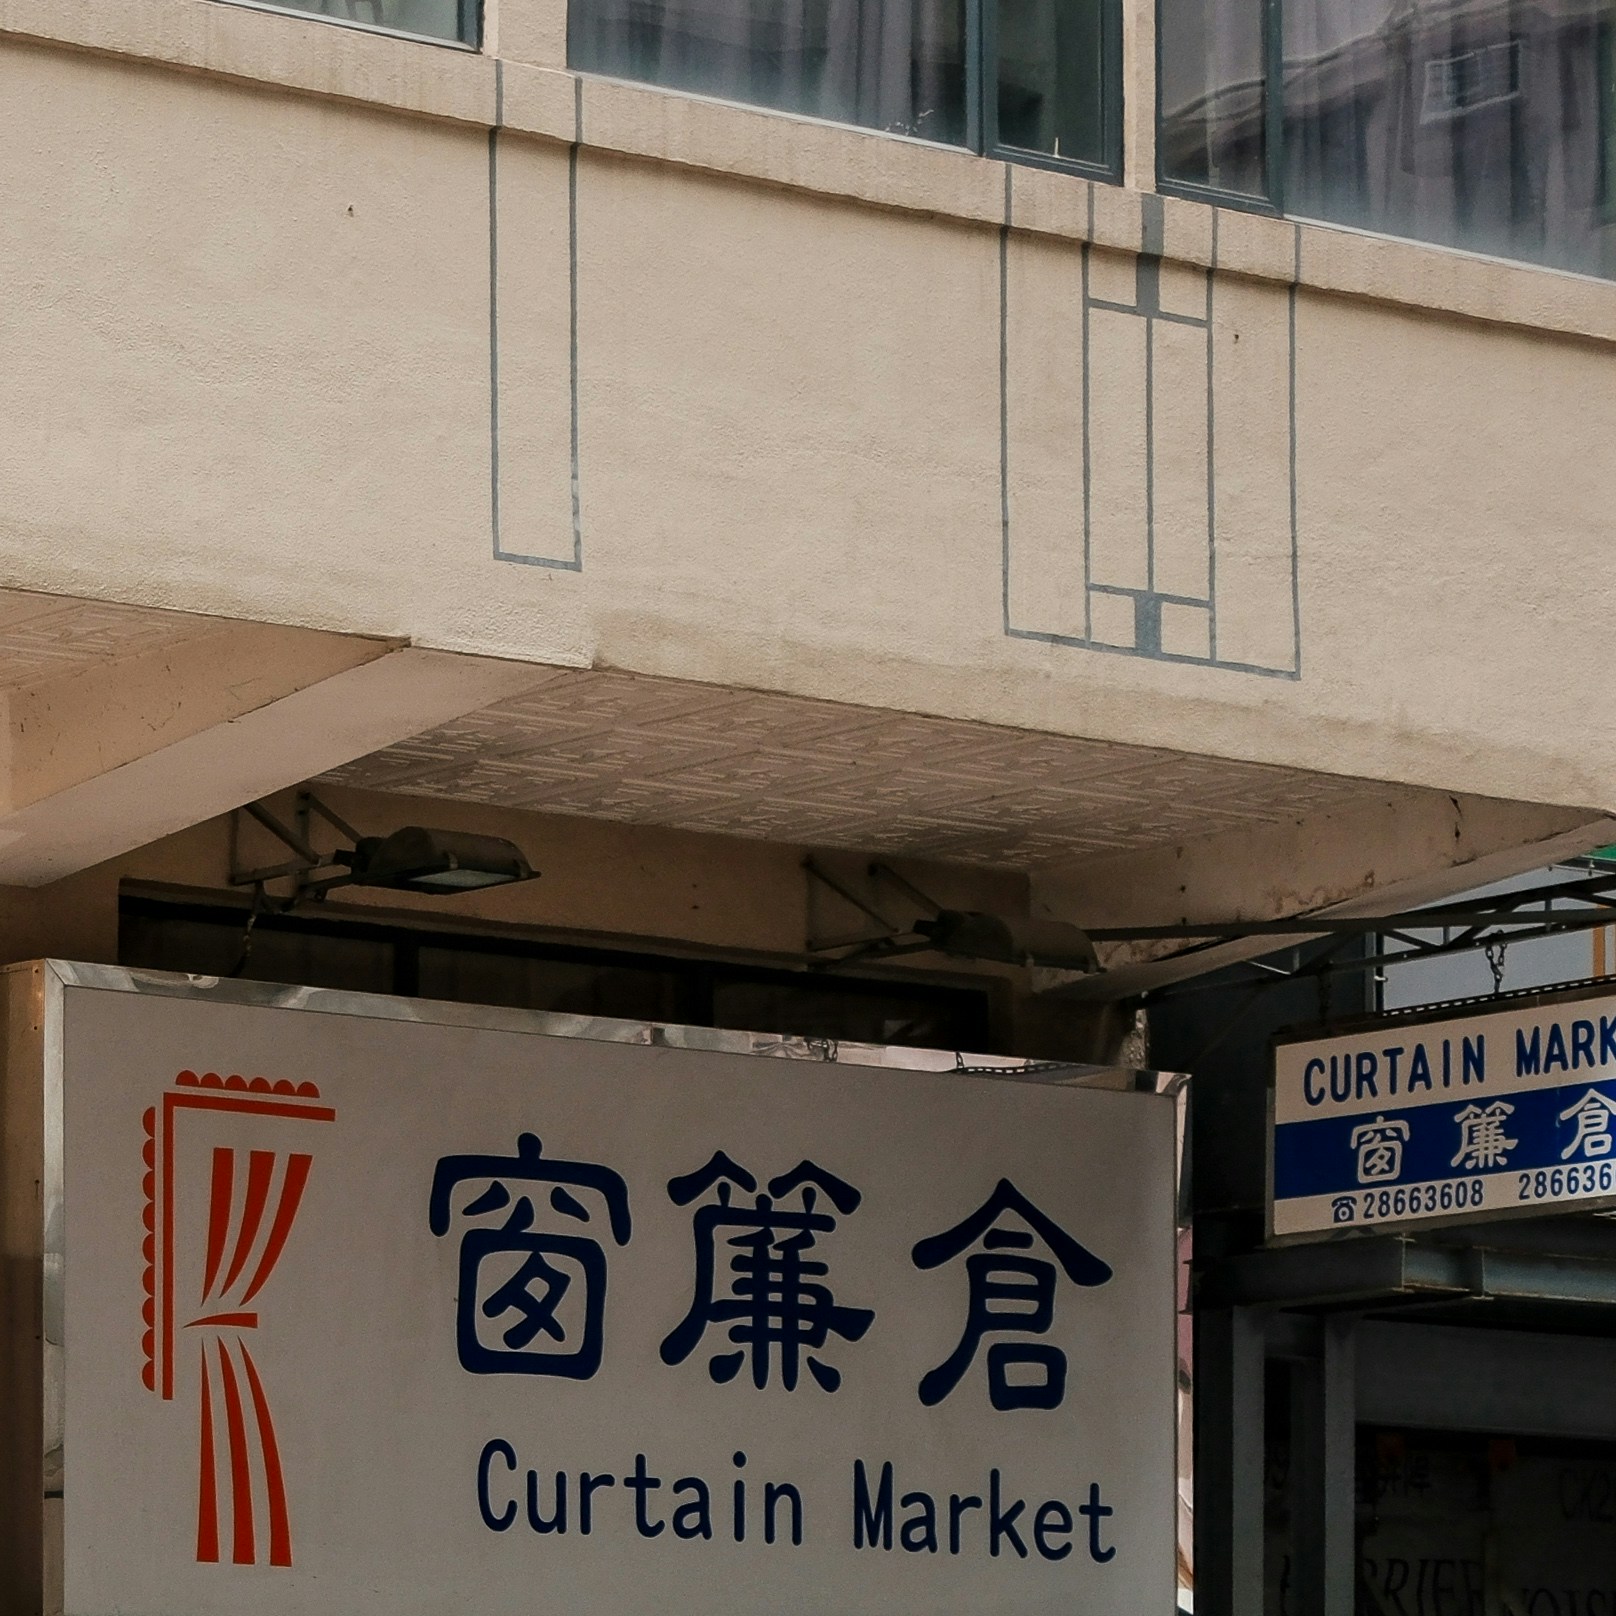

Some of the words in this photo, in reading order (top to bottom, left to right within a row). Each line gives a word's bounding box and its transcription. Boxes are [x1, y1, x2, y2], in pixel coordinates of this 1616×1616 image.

[1303, 1033, 1486, 1106] CURTAIN
[1350, 1087, 1616, 1183] 窗簾倉
[1363, 1178, 1485, 1219] 28663608
[428, 1130, 1114, 1412] 窗簾倉
[476, 1436, 805, 1547] Curtain
[851, 1459, 1117, 1565] Market
